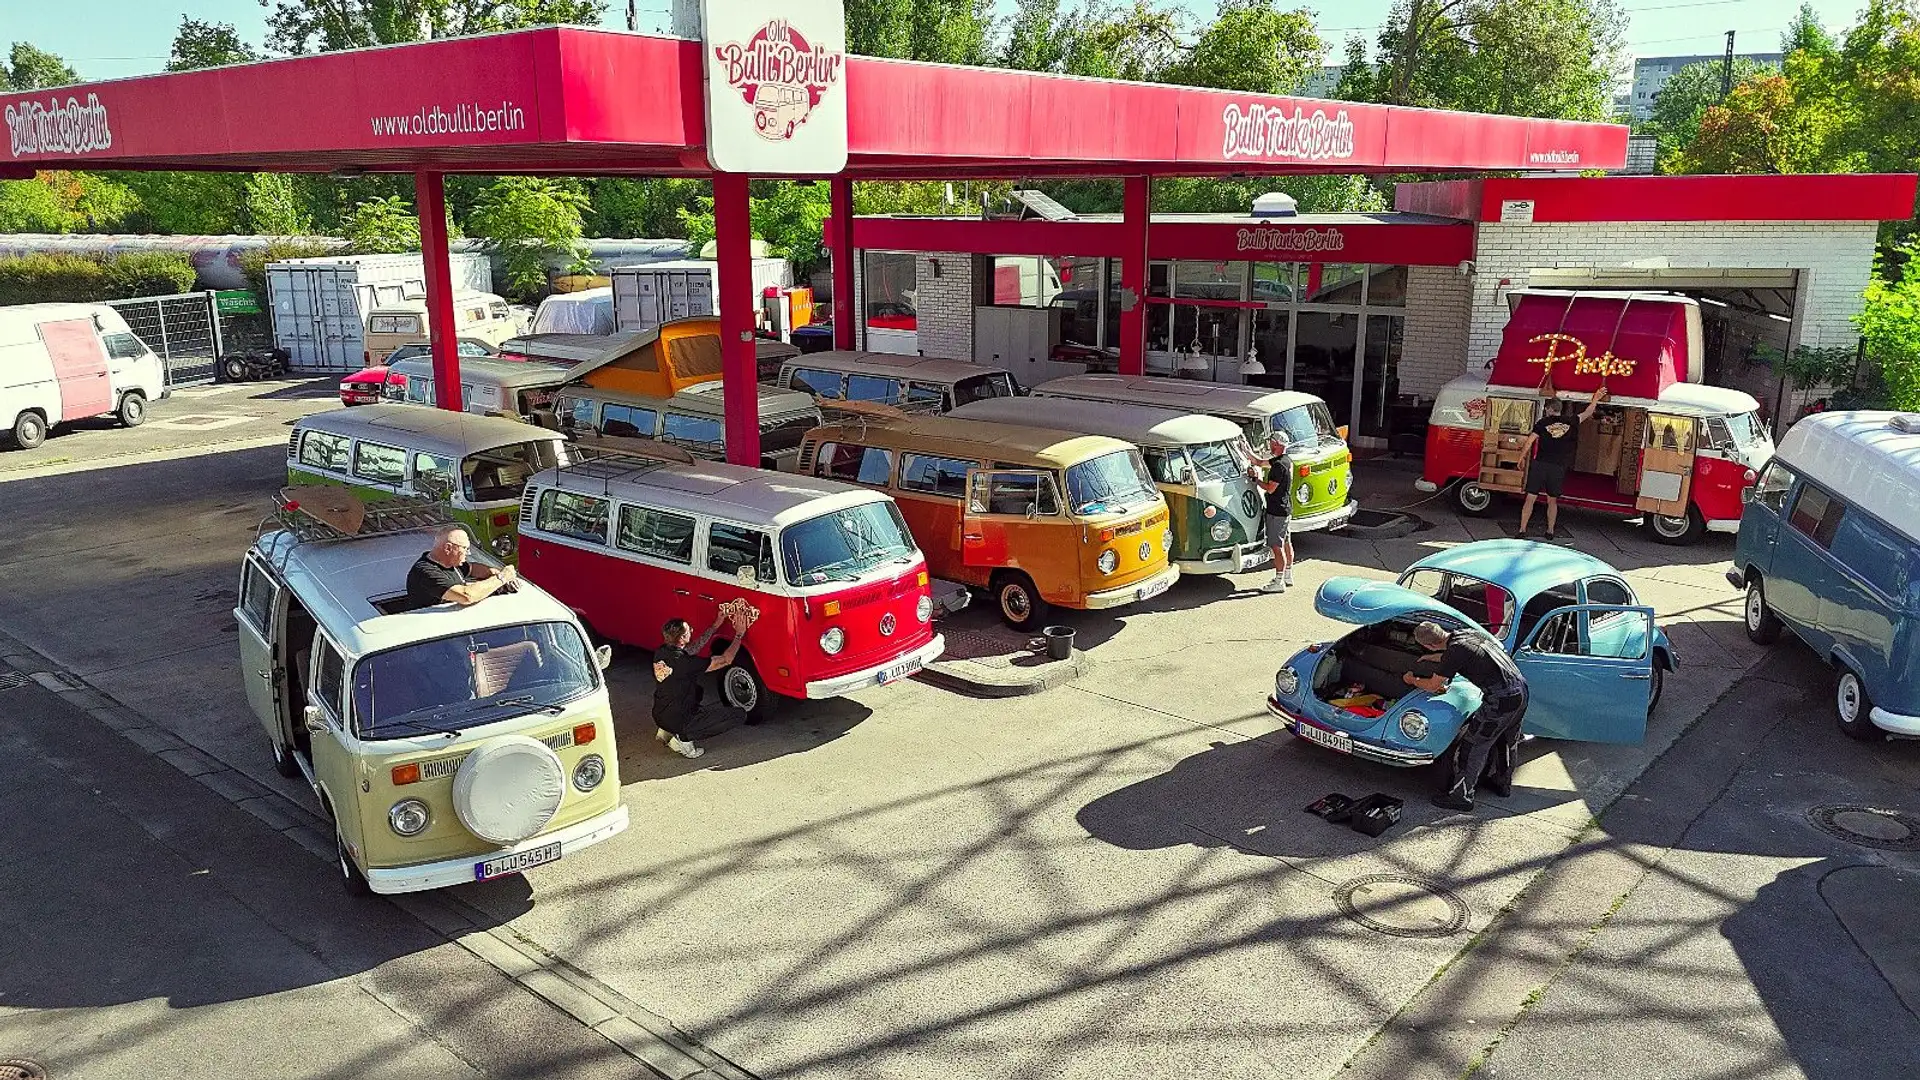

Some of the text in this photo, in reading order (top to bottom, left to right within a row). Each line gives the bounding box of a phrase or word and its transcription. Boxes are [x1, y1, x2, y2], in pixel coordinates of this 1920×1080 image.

[768, 19, 788, 42] Old
[725, 43, 837, 85] Bulli Berlin
[371, 101, 525, 136] www.oldbulli.berlin
[1223, 104, 1266, 160] Bulli
[1311, 109, 1354, 160] Berlin
[1238, 228, 1344, 252] Bulli Tanke Berlin
[1527, 333, 1638, 377] Photos
